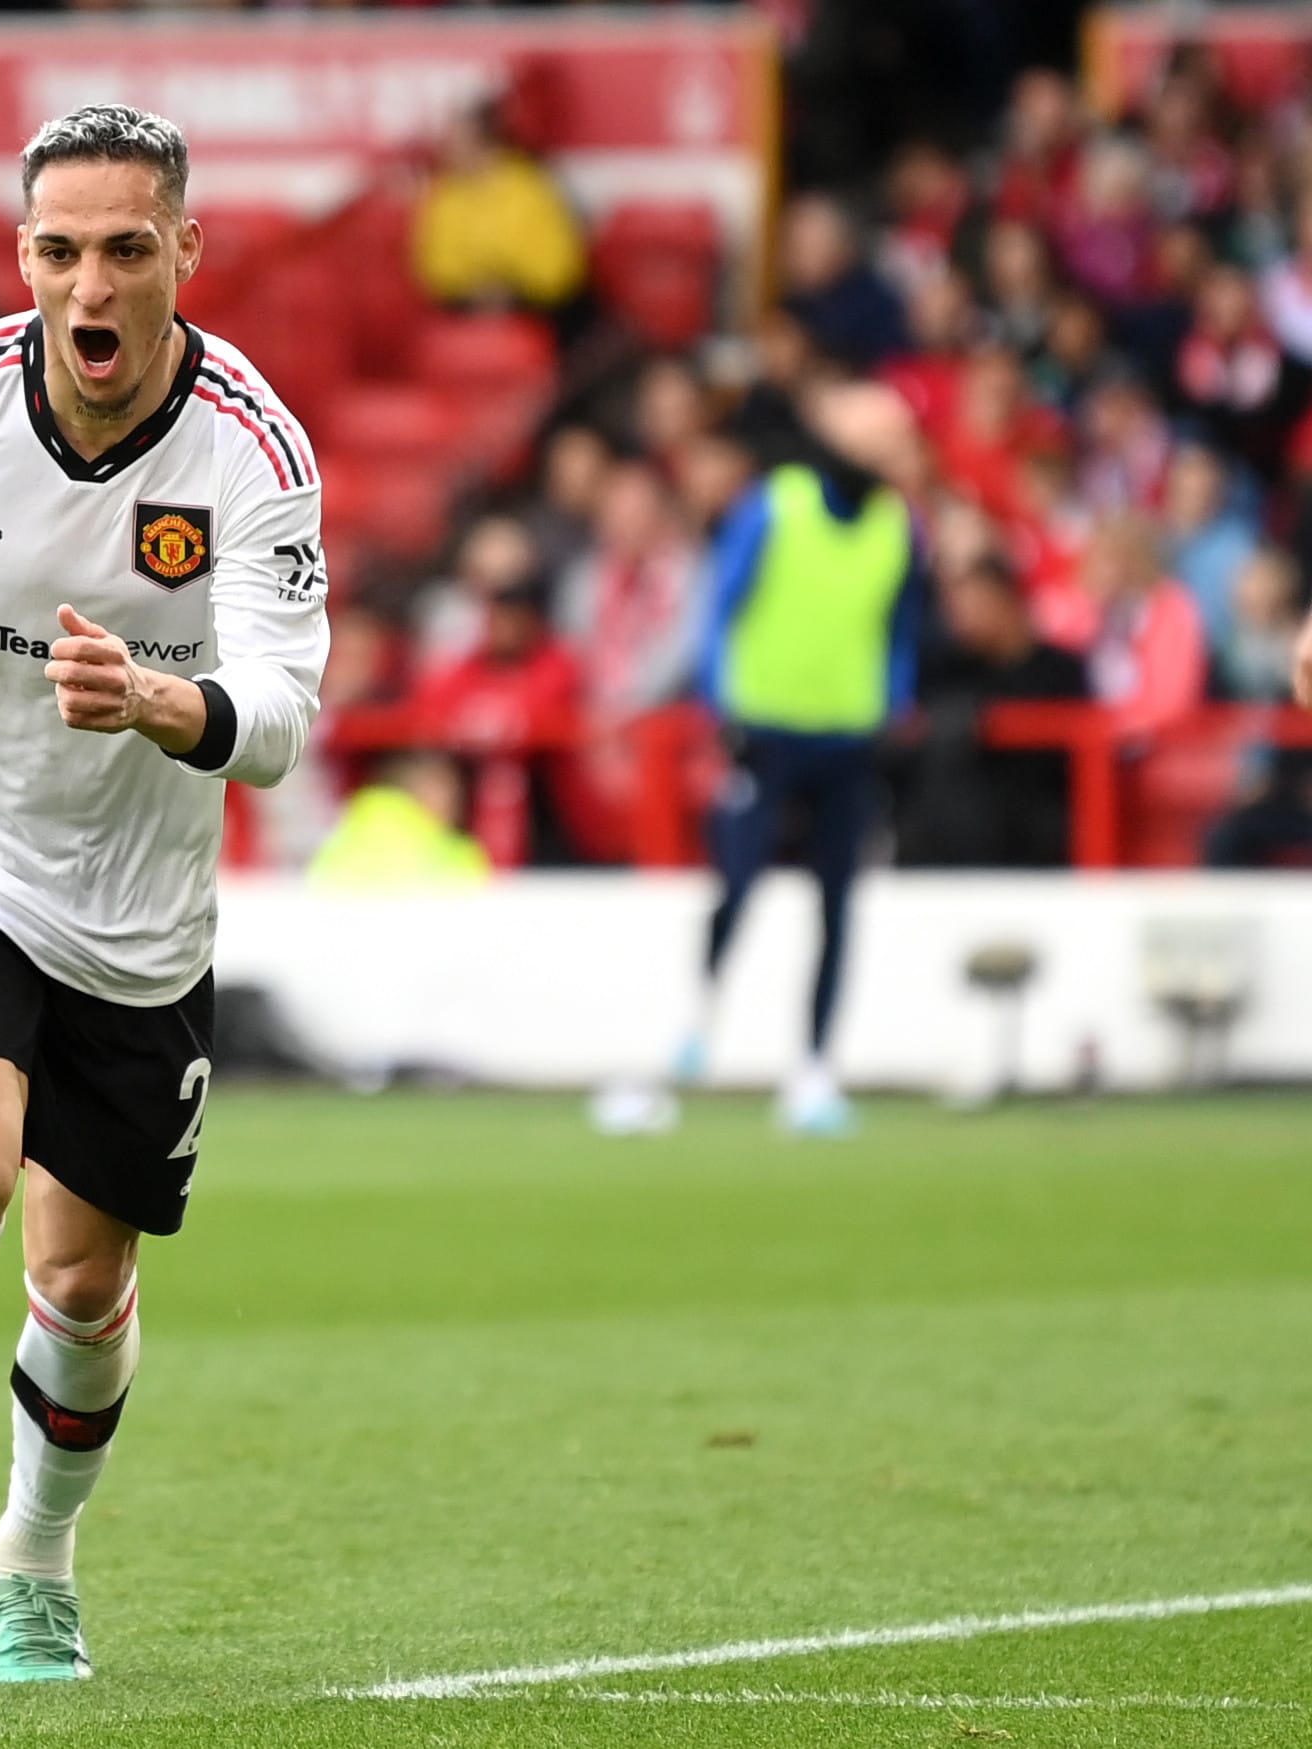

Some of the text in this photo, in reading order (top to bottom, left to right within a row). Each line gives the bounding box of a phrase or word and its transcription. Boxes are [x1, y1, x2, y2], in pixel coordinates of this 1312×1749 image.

[147, 517, 199, 541] MANCHESTER
[155, 562, 192, 574] UNITED
[167, 1057, 211, 1160] 2
